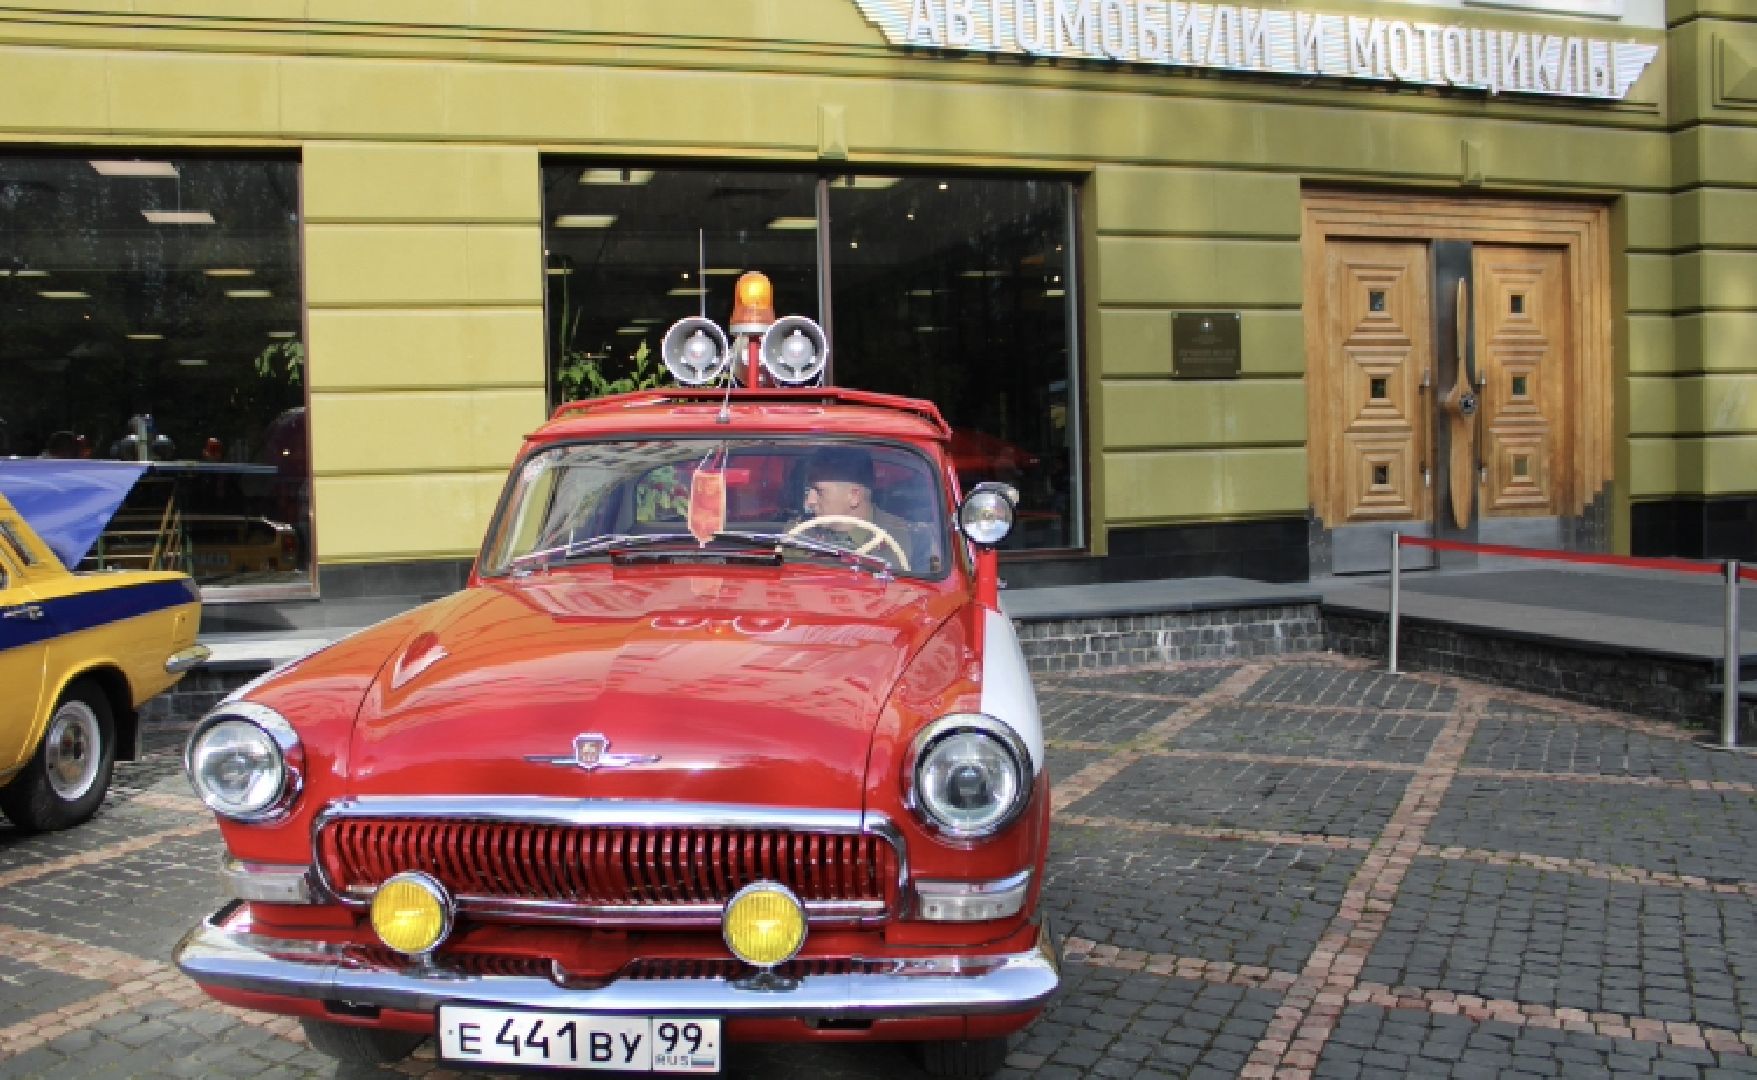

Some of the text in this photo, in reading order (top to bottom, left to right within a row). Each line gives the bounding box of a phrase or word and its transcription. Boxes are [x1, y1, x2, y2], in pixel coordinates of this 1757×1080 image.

[906, 0, 1617, 96] АВТОМОБИЛИ И МОТОЦИКЛЫ
